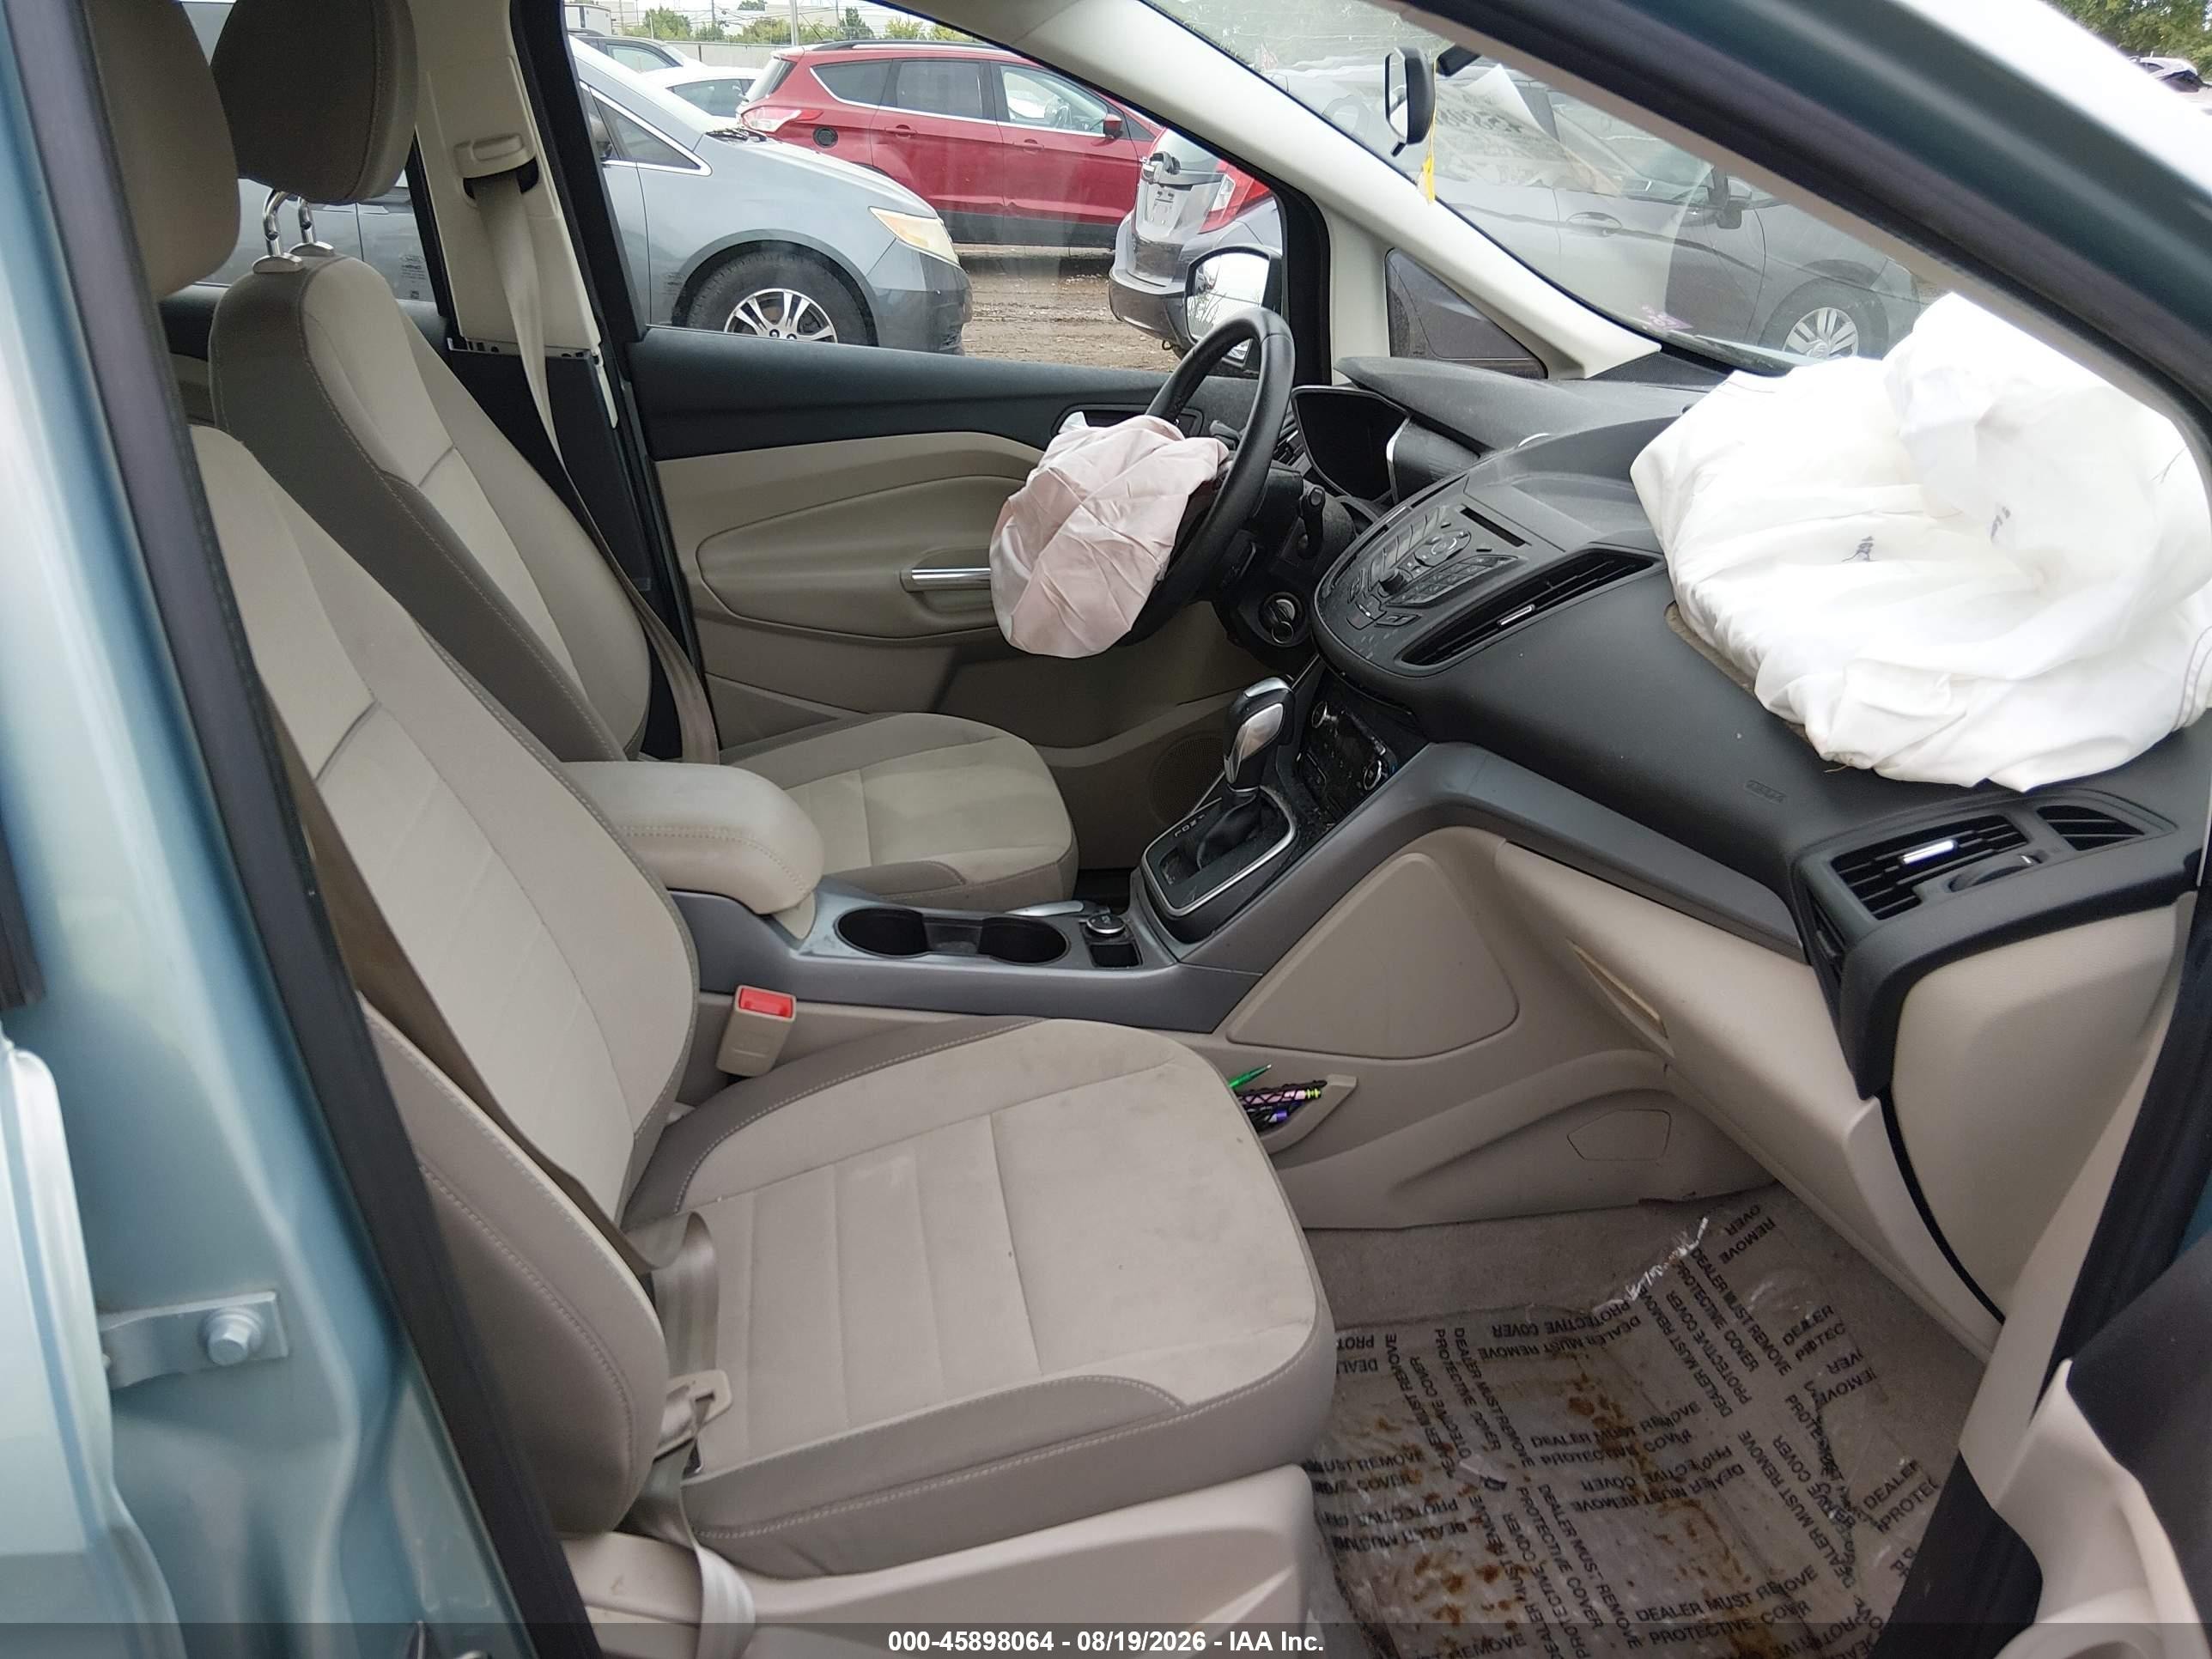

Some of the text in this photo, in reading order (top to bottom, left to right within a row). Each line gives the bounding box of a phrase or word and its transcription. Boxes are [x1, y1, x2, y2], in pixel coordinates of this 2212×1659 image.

[1718, 1218, 1777, 1264] REMOVE
[1477, 1315, 1642, 1361] DEALER MUST REMOVE
[1492, 1300, 1632, 1339] PROTECTIVE COVER
[1433, 1328, 1477, 1407] PROTECTIVE
[1454, 1327, 1482, 1379] DEALER
[1692, 1328, 1753, 1405] PROTECTIVE
[1724, 1328, 1760, 1372] COVER
[1747, 1322, 1793, 1376] REMOVE
[1409, 1356, 1438, 1398] COVER
[1692, 1368, 1734, 1419] DEALER
[1737, 1429, 1786, 1491] REMOVE
[1778, 1487, 1814, 1528] MUST
[1771, 1434, 1811, 1483] COVER
[1571, 1495, 1641, 1512] REMOVE
[1579, 1476, 1637, 1492] COVER
[1516, 1486, 1605, 1631] PROTECTIVE COVER
[1538, 1484, 1578, 1539] DEALER
[1595, 1583, 1644, 1649] REMOVE
[1528, 1560, 1592, 1659] PROTECTIVE
[1635, 1600, 1705, 1623] DEALER
[1704, 1591, 1753, 1612] MUST
[1649, 1618, 1756, 1646] PROTECTIVE
